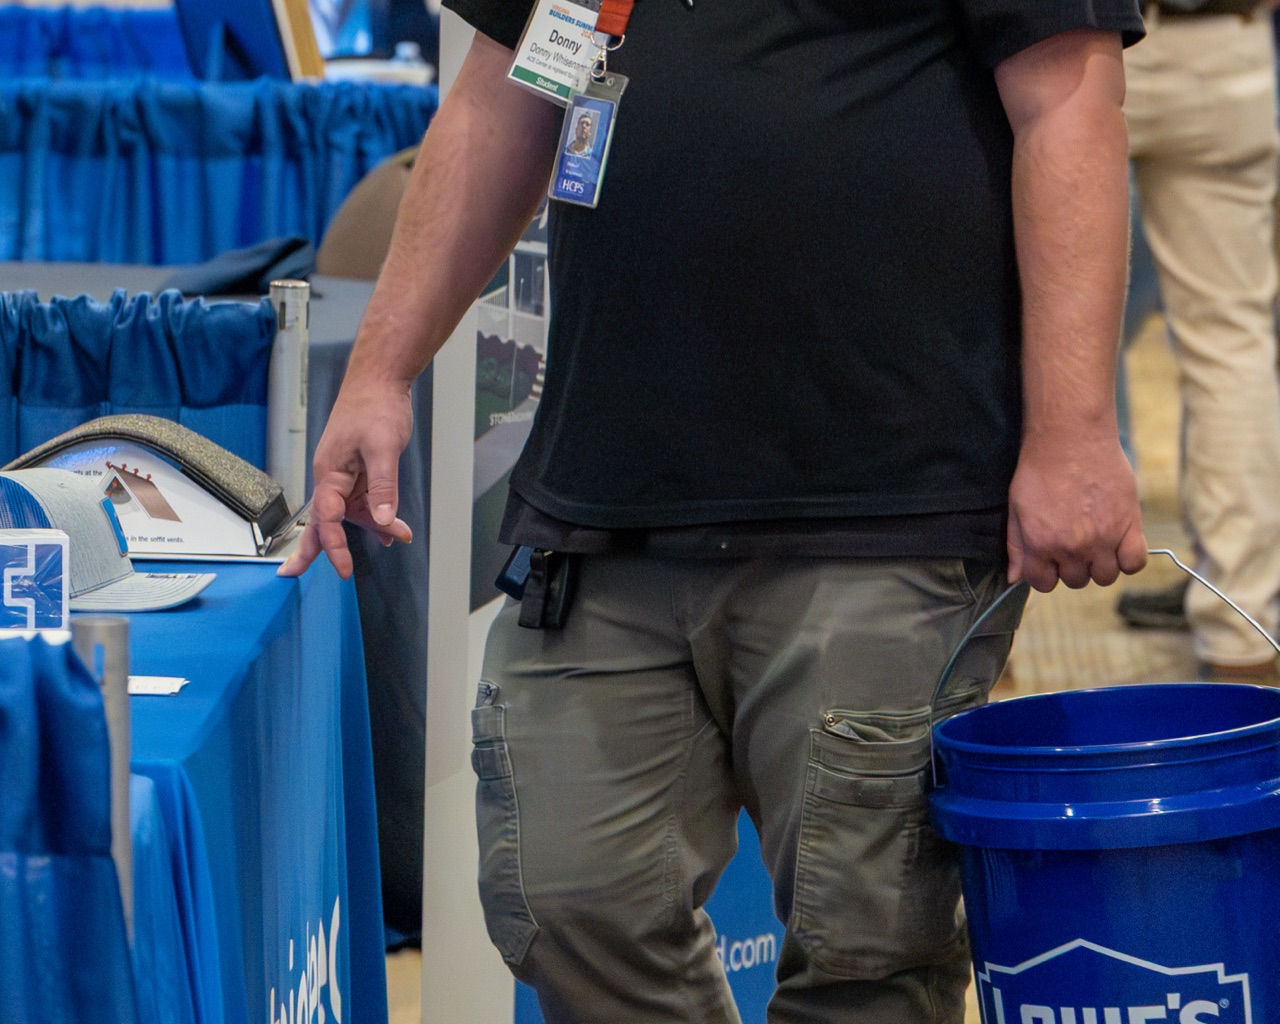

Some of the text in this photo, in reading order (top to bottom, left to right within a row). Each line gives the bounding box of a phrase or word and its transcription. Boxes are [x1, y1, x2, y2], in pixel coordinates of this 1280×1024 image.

[548, 9, 595, 32] BUILDERS SUMM
[529, 42, 553, 61] Donny
[548, 29, 582, 56] Donny
[535, 76, 559, 93] Student
[562, 178, 585, 194] HCPS
